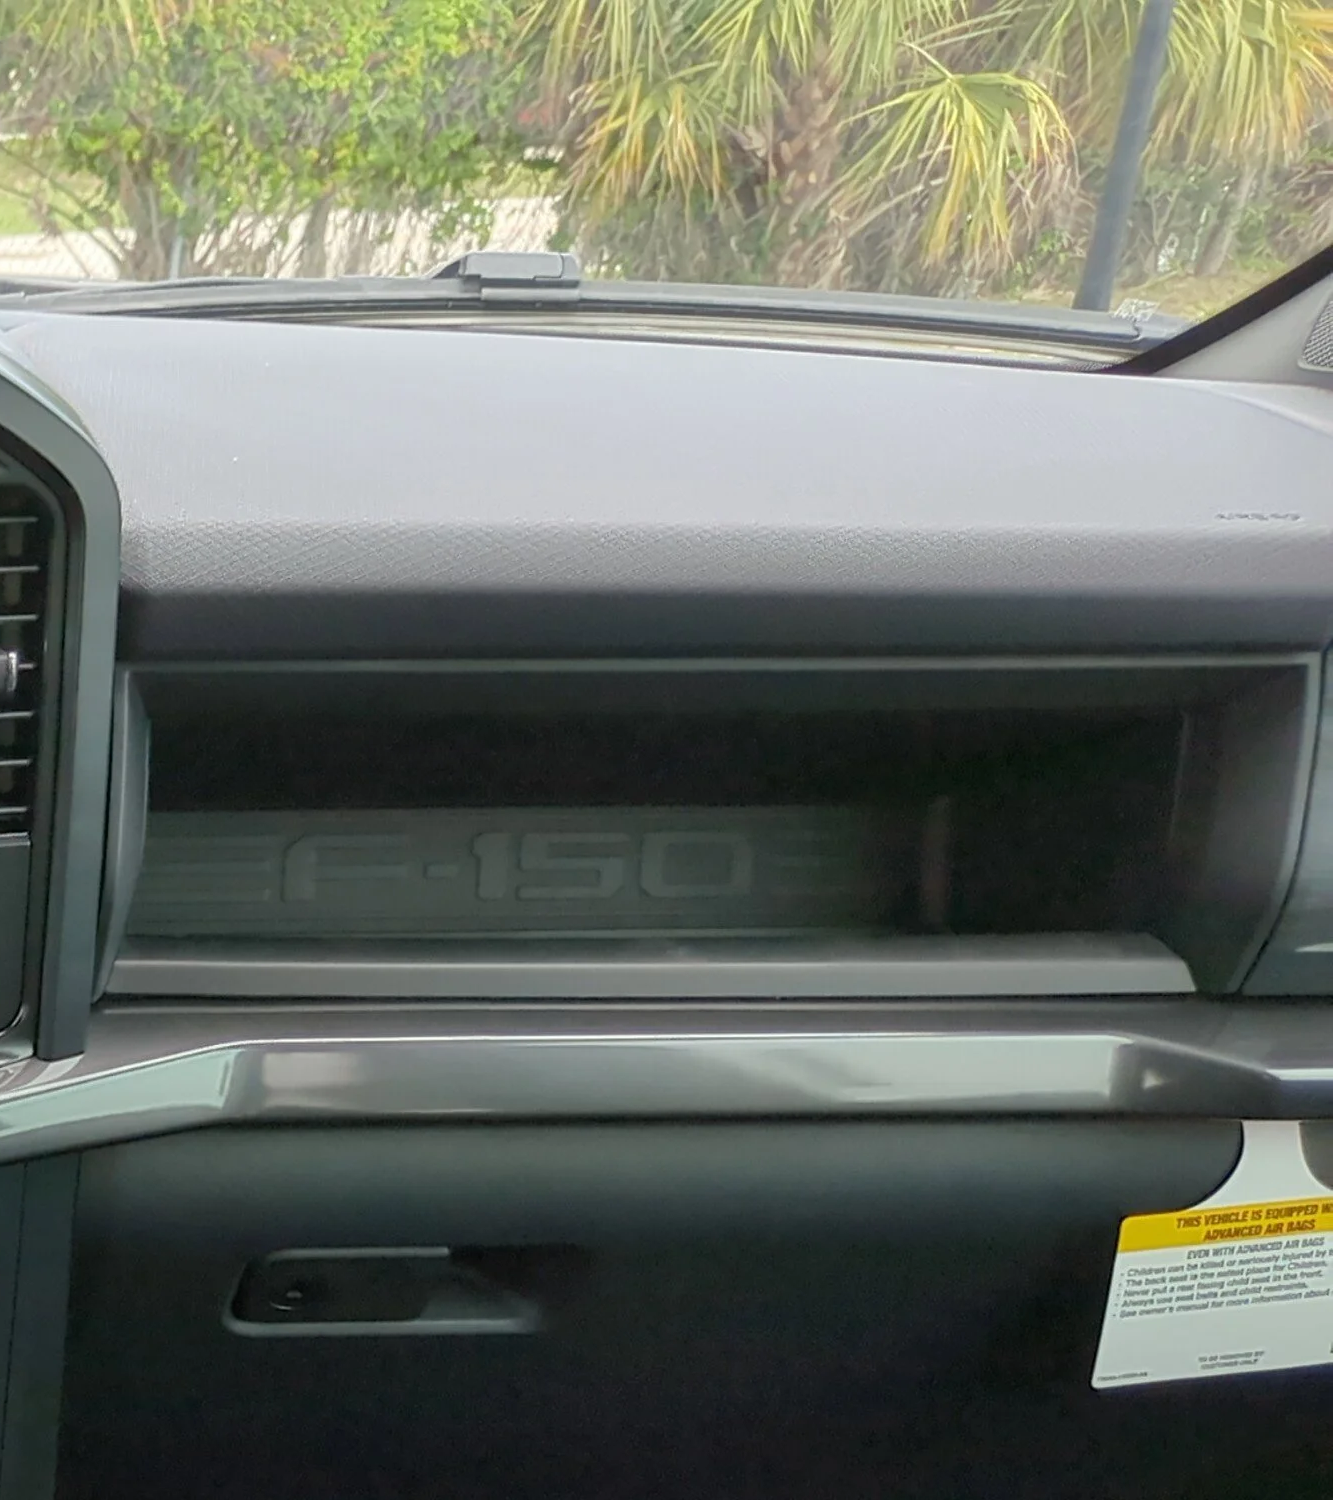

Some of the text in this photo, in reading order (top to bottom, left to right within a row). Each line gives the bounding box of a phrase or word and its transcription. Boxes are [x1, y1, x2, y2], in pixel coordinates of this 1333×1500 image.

[282, 830, 754, 901] F-150
[1176, 1215, 1201, 1228] THIS
[1204, 1209, 1248, 1226] VEHICLE
[1250, 1208, 1262, 1221] IS
[1264, 1202, 1318, 1220] EQUIPPED
[1203, 1218, 1316, 1241] ADVANCED AIR BAGS
[1283, 1239, 1299, 1249] AIR
